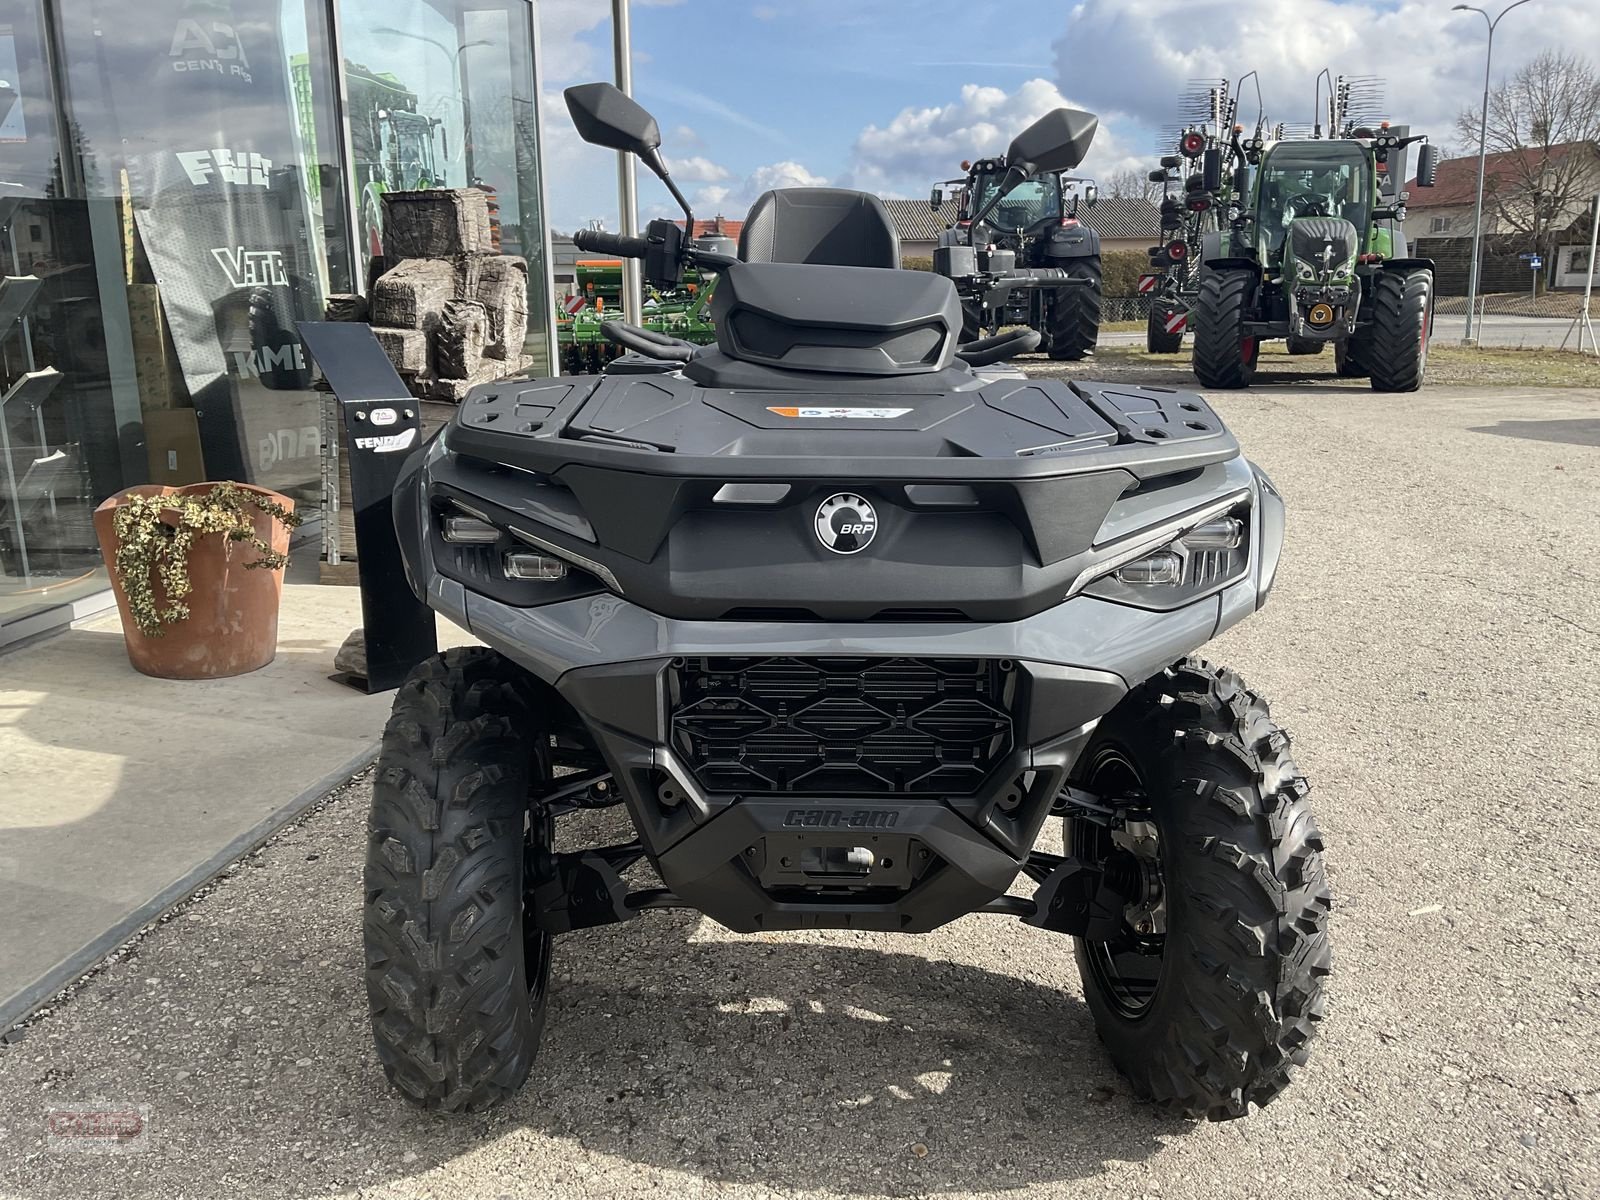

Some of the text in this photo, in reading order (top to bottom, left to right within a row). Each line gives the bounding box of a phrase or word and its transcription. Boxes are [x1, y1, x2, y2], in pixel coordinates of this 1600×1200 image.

[354, 433, 407, 450] FENDT
[840, 523, 875, 535] BRP
[783, 809, 900, 828] can-am
